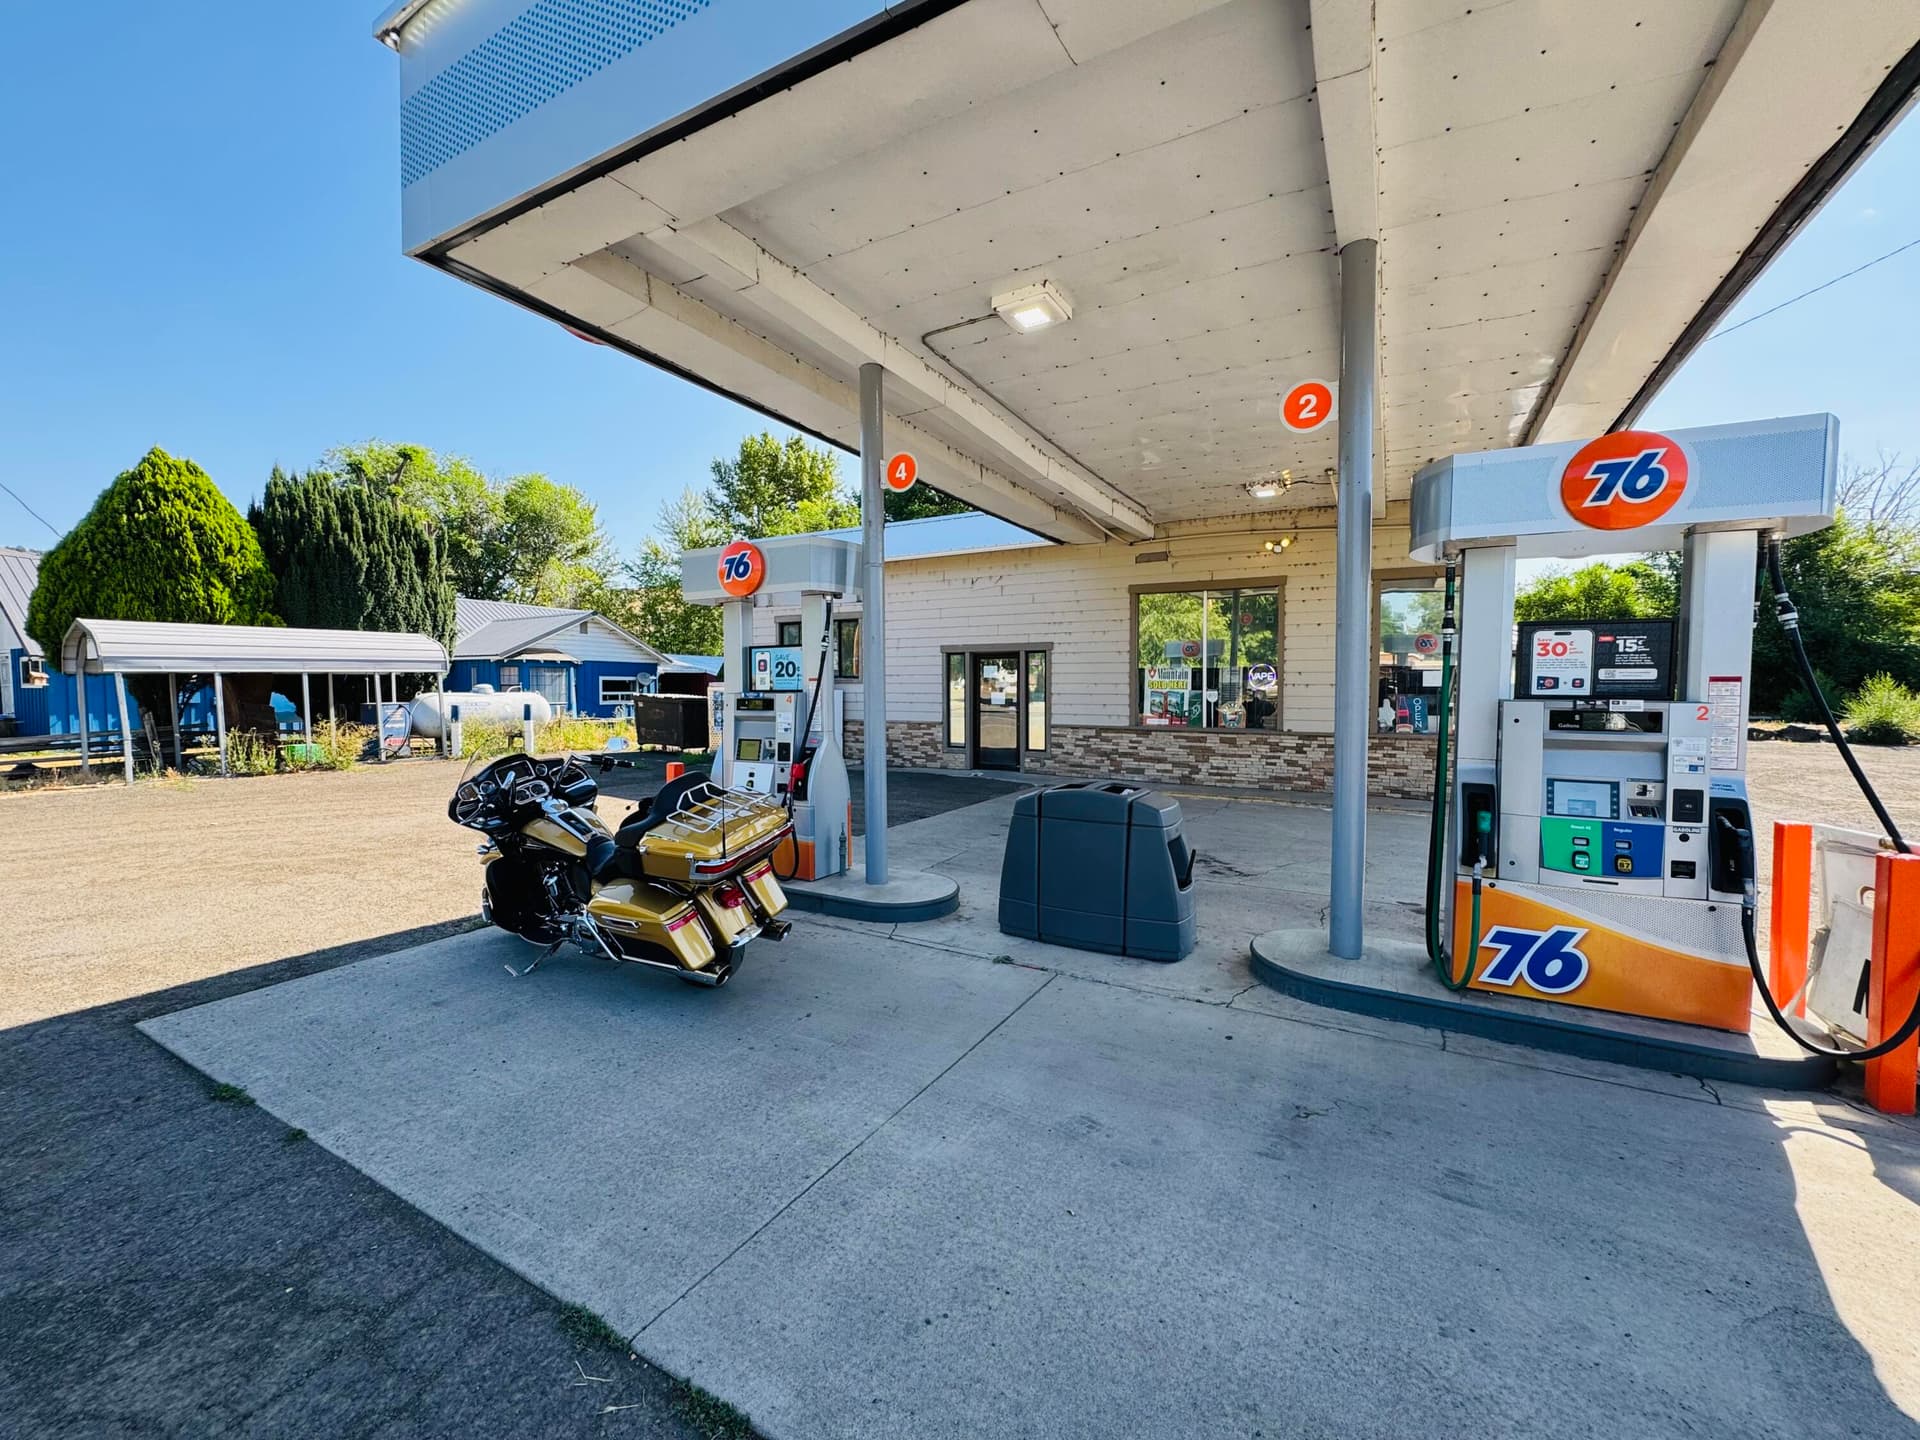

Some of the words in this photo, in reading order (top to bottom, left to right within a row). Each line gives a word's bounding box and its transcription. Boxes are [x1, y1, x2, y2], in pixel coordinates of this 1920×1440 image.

[1298, 394, 1317, 419] 2
[895, 462, 907, 480] 4
[1581, 448, 1668, 507] 76
[723, 550, 752, 583] 76
[1251, 672, 1273, 681] VAPE
[785, 695, 793, 704] 4
[1696, 706, 1709, 721] 2
[1478, 925, 1589, 994] 76
